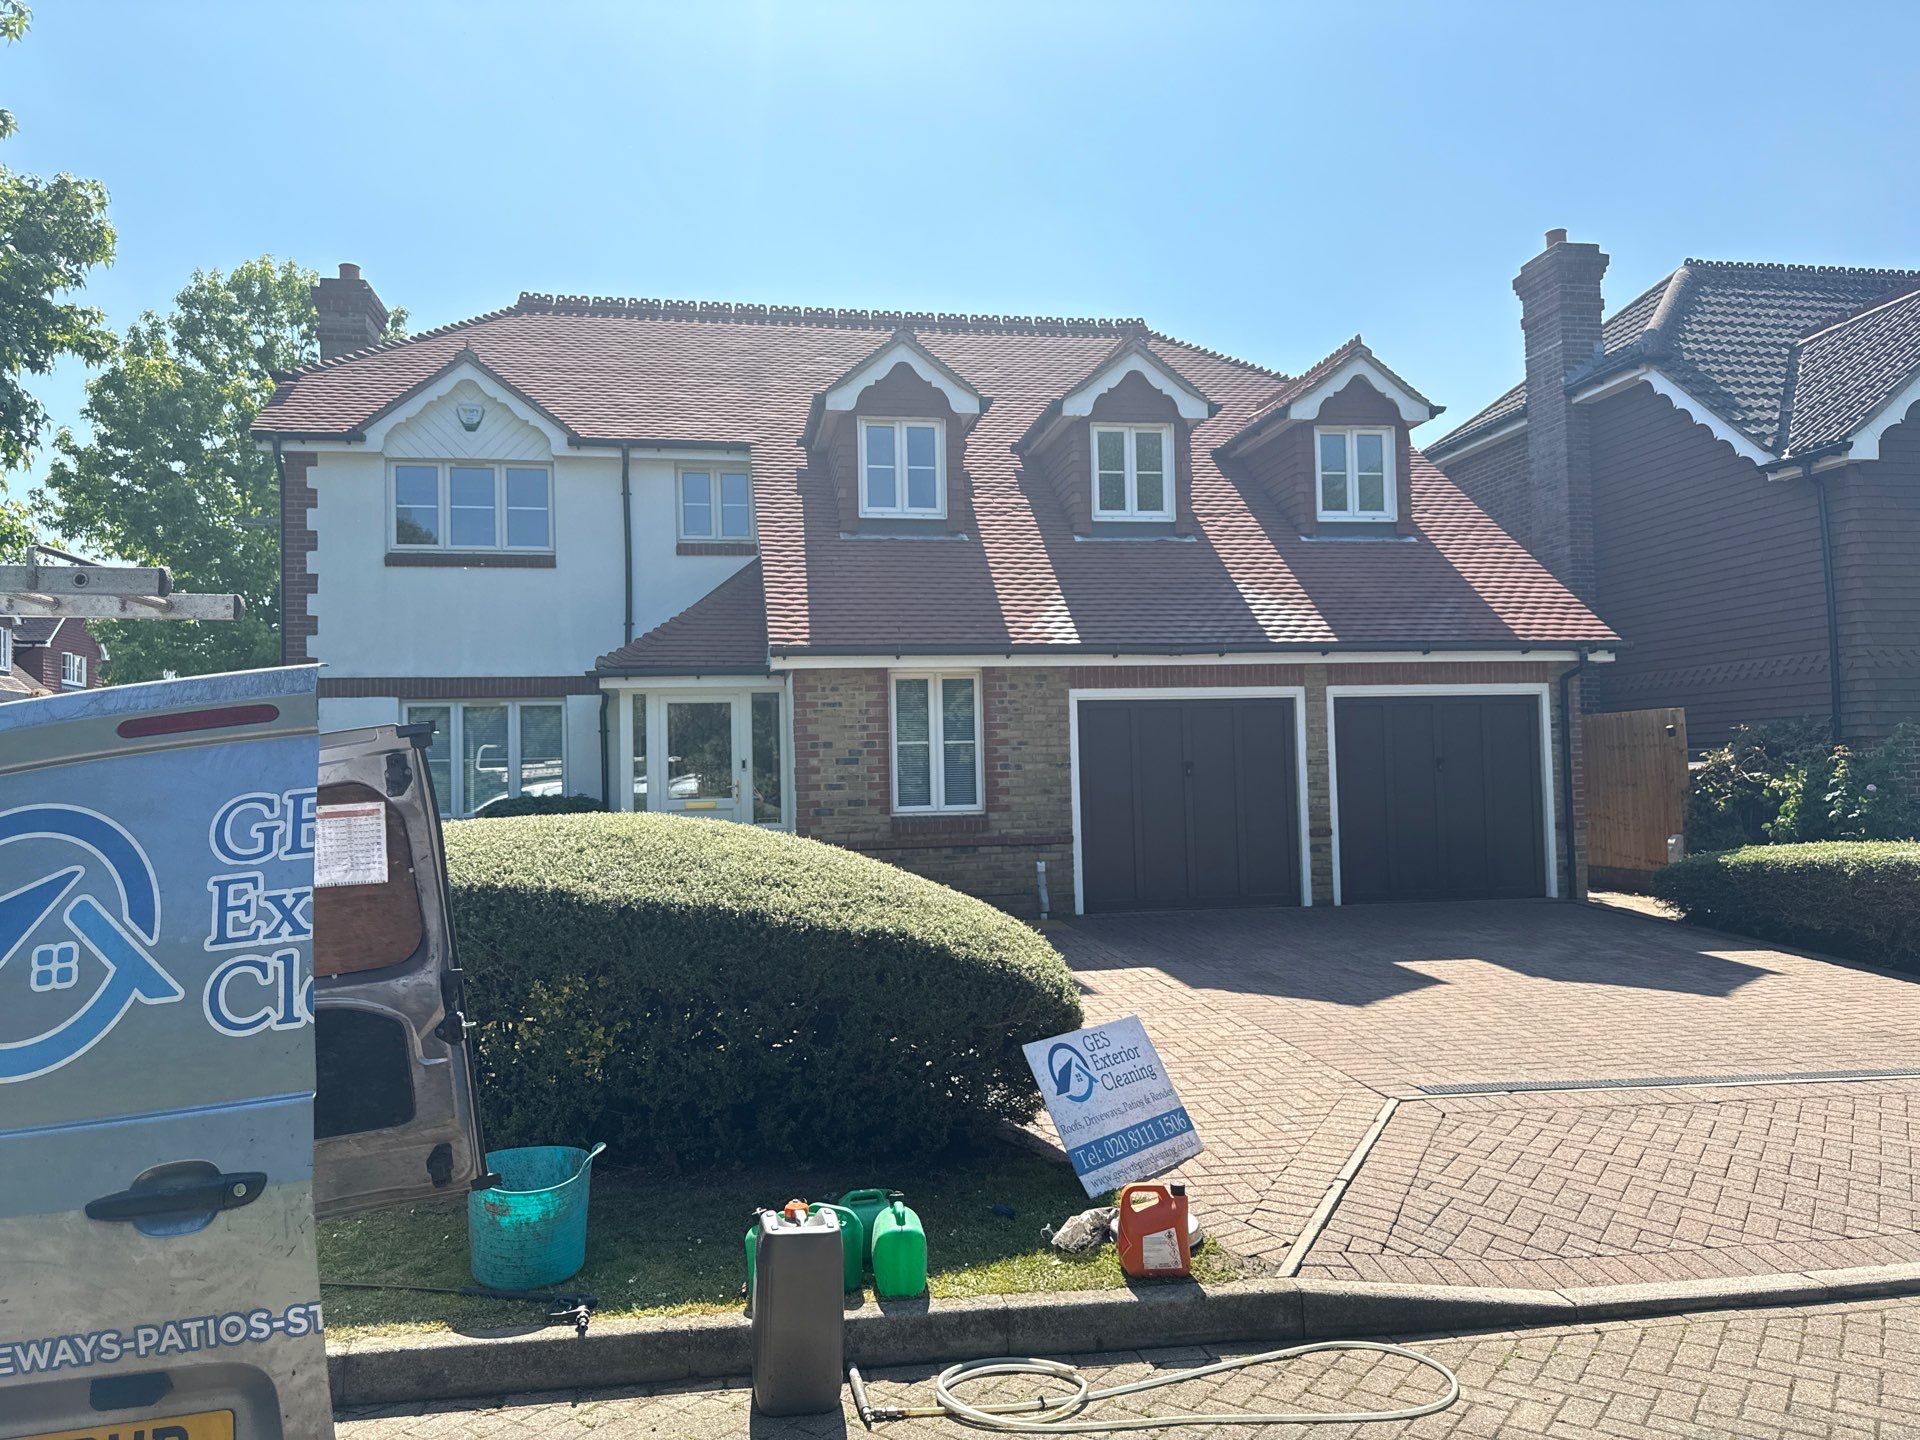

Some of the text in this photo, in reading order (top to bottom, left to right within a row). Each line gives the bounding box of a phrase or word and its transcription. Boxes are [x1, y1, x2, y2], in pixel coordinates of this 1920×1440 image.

[203, 948, 315, 1037] Cl
[1082, 1031, 1111, 1052] GES
[1090, 1046, 1140, 1071] Exterior
[1101, 1064, 1157, 1091] Cleaning
[1060, 1119, 1085, 1135] Roofs,
[1122, 1097, 1145, 1112] Patios
[1143, 1095, 1151, 1105] &
[1149, 1087, 1174, 1103] Render
[1075, 1112, 1187, 1169] Tel: 020 8111 1506
[1091, 1137, 1196, 1188] www.gesexteriorcleaning.co.uk
